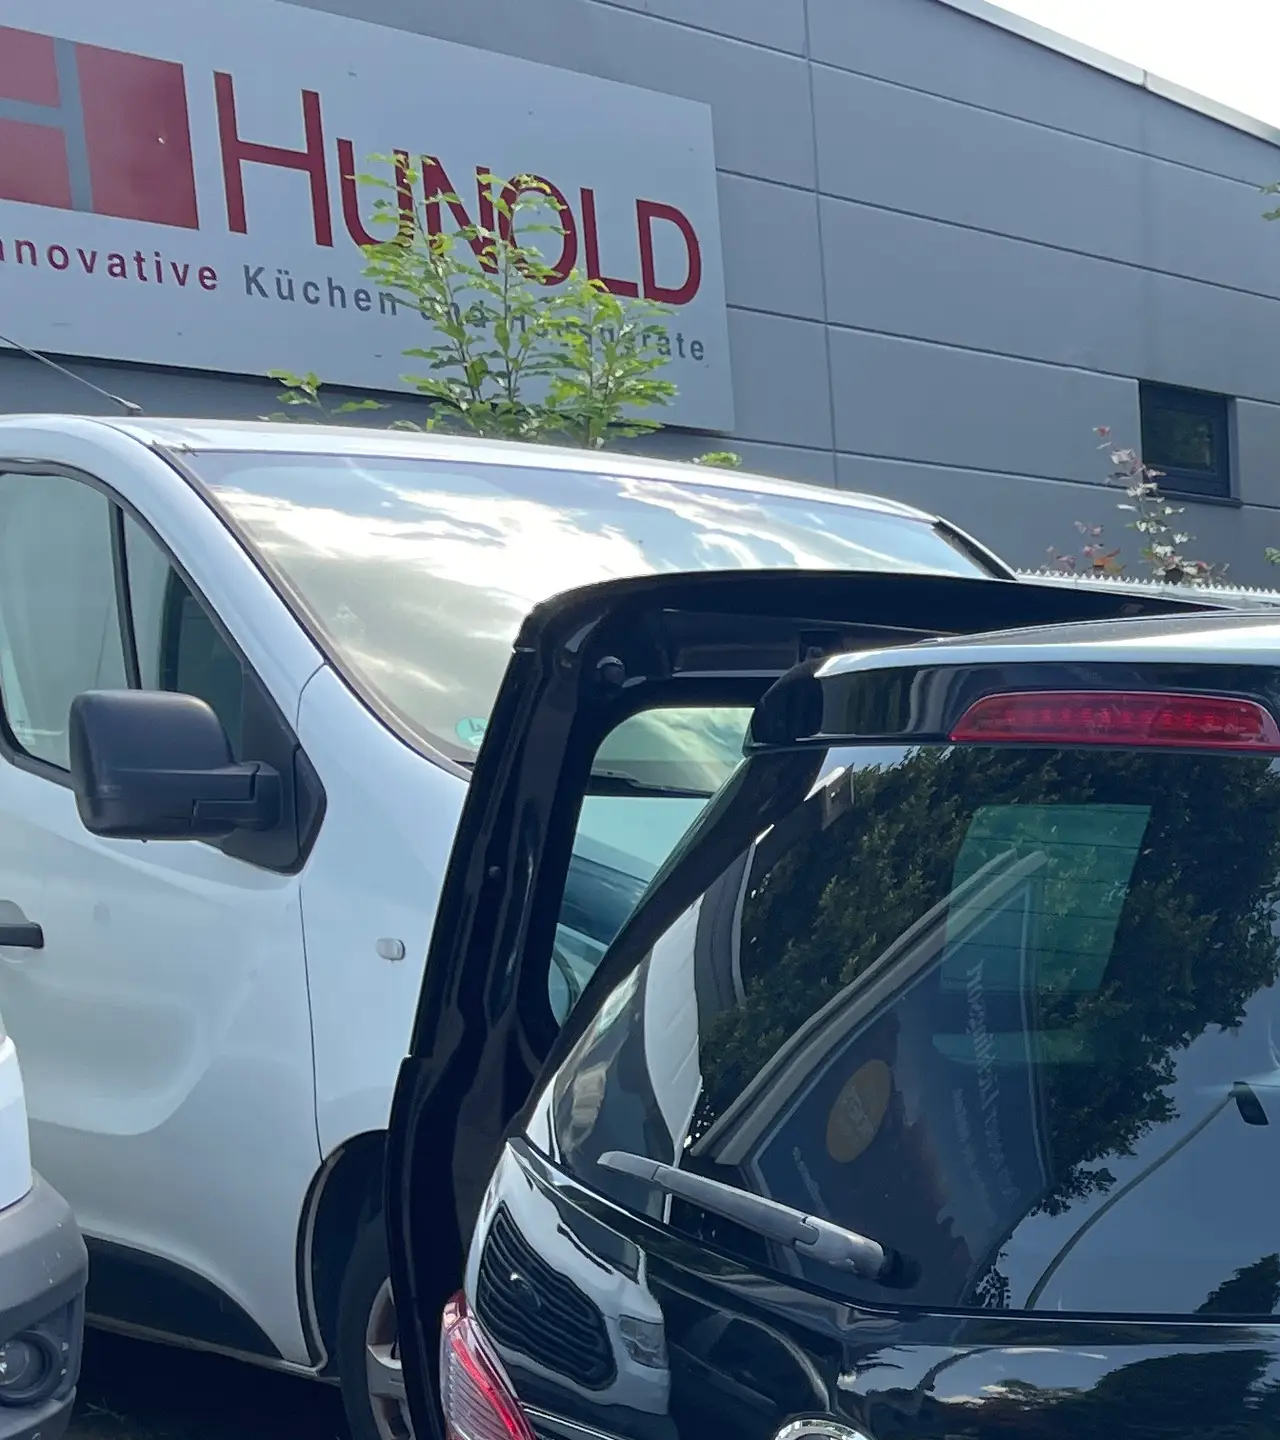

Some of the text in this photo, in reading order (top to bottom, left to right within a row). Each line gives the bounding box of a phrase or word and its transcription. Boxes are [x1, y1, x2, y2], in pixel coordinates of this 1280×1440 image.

[213, 69, 702, 305] HUNOLD
[0, 237, 217, 290] novative
[243, 264, 397, 316] Küchen
